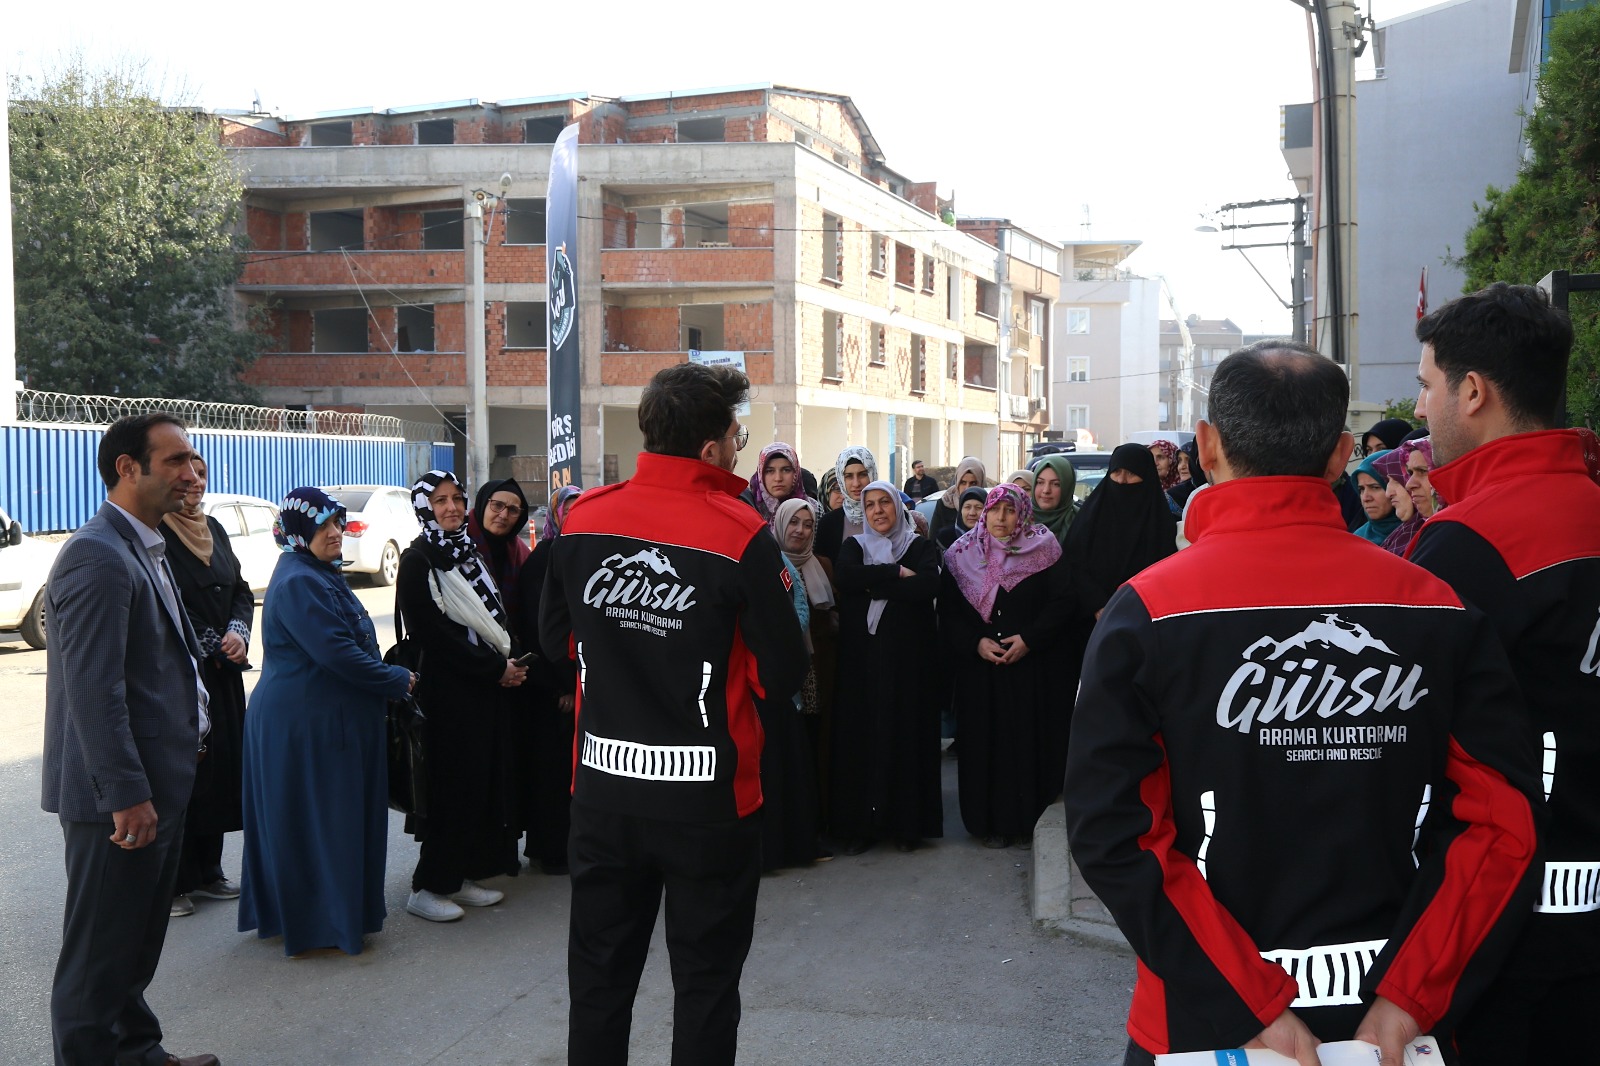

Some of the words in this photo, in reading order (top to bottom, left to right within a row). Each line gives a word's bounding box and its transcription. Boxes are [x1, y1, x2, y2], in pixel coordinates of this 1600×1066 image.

[583, 567, 696, 611] Gürsu
[605, 606, 639, 620] ARAMA
[641, 610, 683, 630] KURTARMA
[619, 620, 642, 630] SEARCH
[642, 623, 652, 633] AND
[1216, 658, 1428, 734] Gürsu
[1259, 728, 1317, 746] ARAMA
[1323, 725, 1407, 745] KURTARMA
[1286, 749, 1324, 762] SEARCH
[1326, 748, 1348, 761] AND
[1350, 747, 1383, 760] RESCUE
